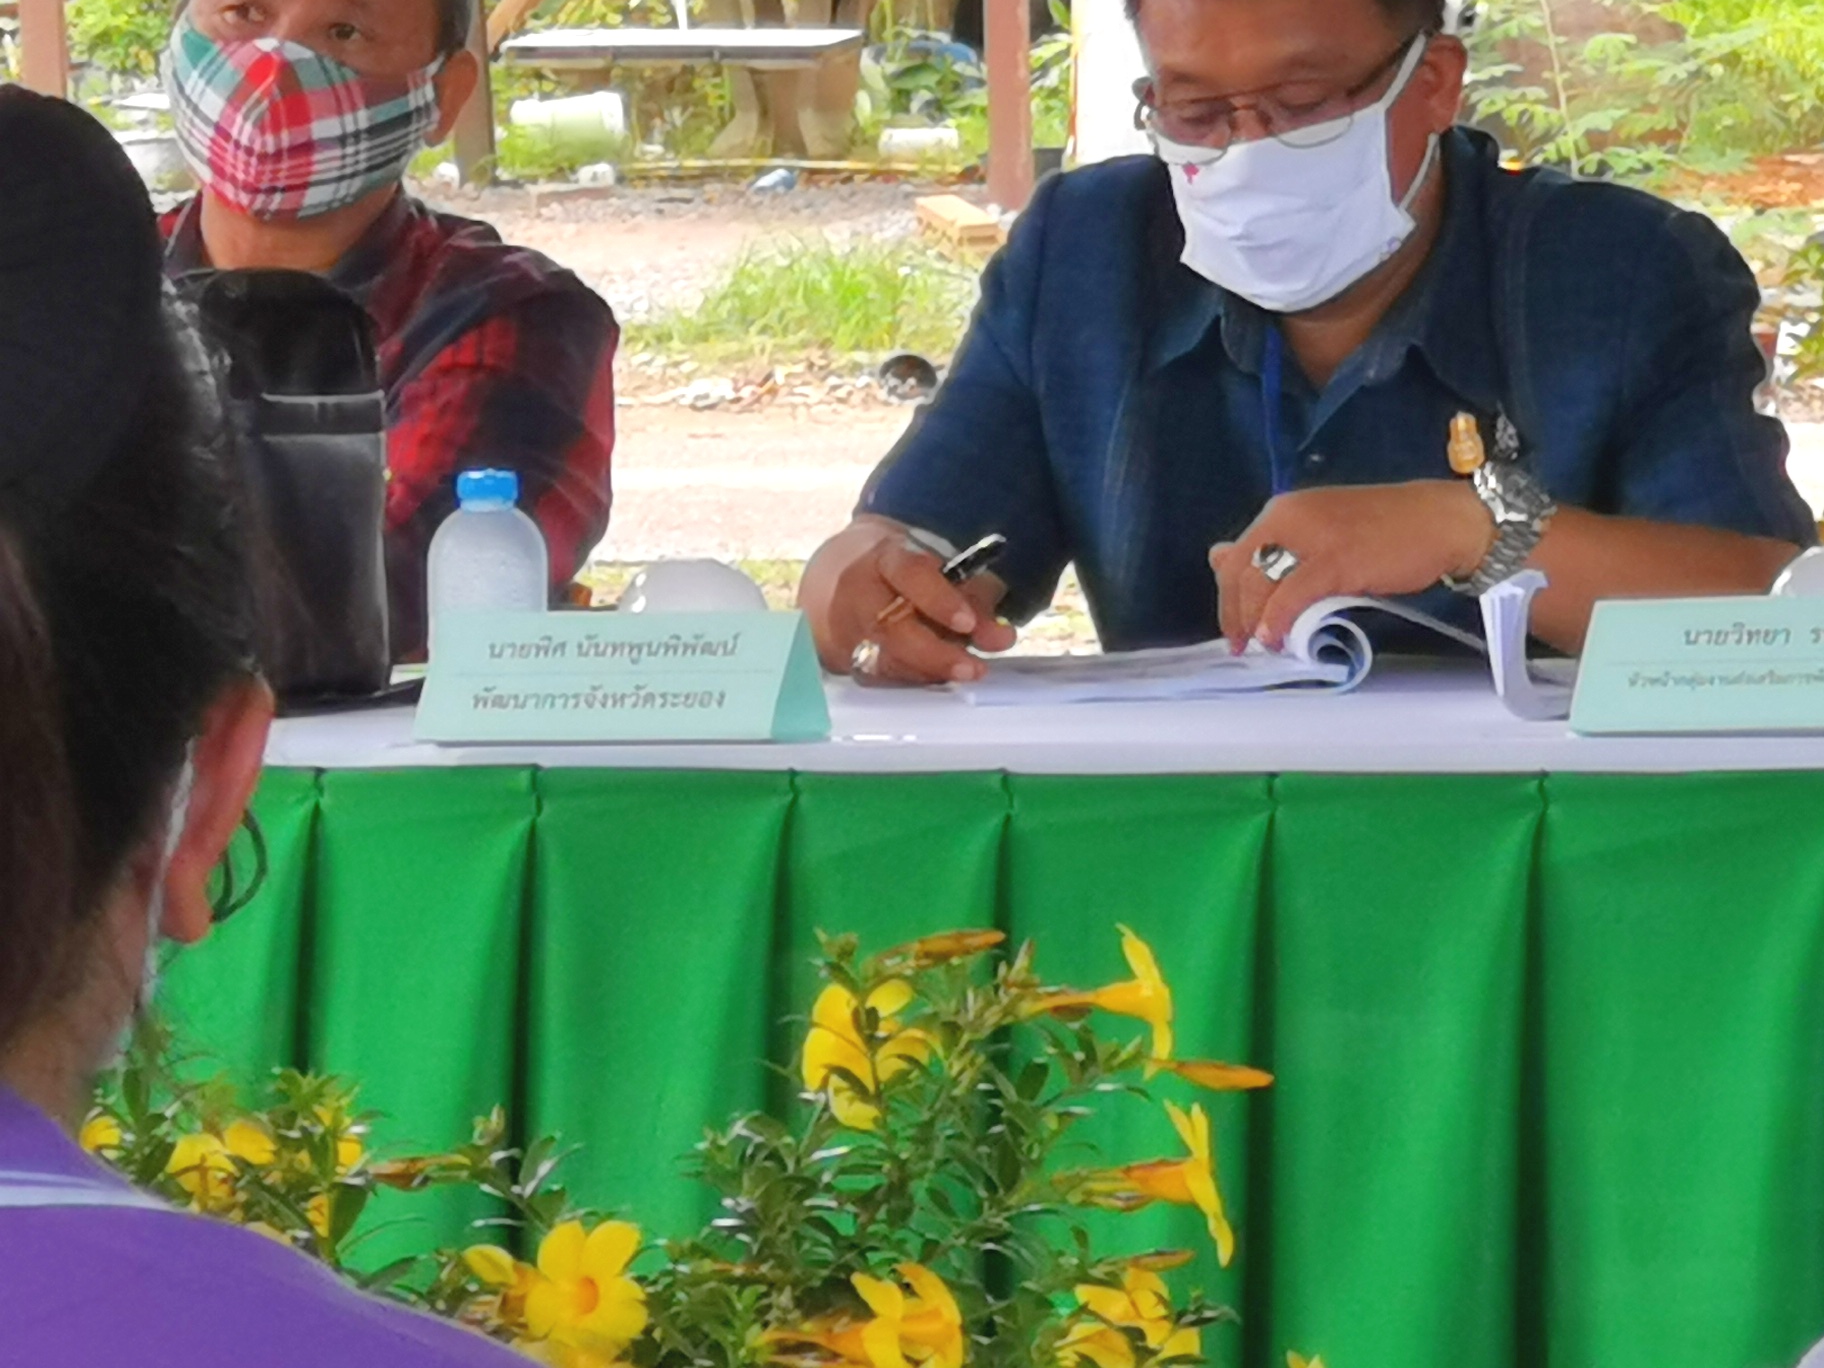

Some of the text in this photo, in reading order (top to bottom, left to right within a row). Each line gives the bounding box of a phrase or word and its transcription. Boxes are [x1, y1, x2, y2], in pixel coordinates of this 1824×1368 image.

[1684, 621, 1792, 646] นายวิทยา
[472, 684, 727, 710] พัฒนาการจังหวัดระยอง
